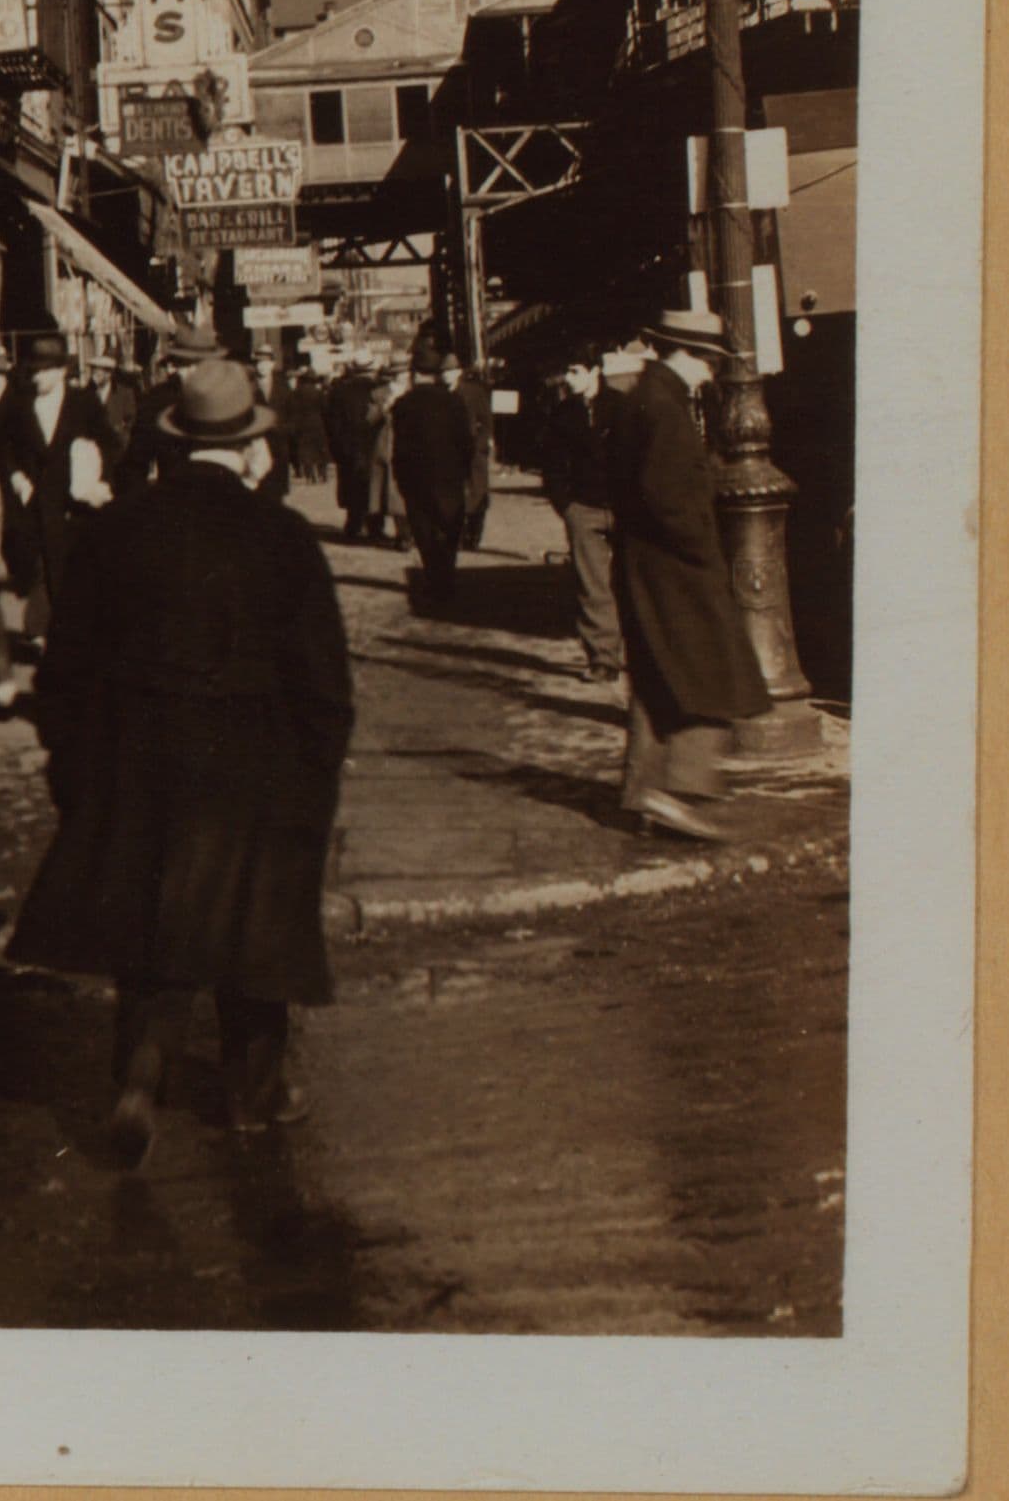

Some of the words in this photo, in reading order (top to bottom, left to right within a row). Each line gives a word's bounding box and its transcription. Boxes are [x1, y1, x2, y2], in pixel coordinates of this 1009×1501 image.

[125, 117, 194, 142] DENTIS
[179, 173, 293, 203] TAVERN
[187, 211, 219, 228] BAR
[236, 208, 287, 227] GRILL
[190, 227, 286, 245] RESTAURANT
